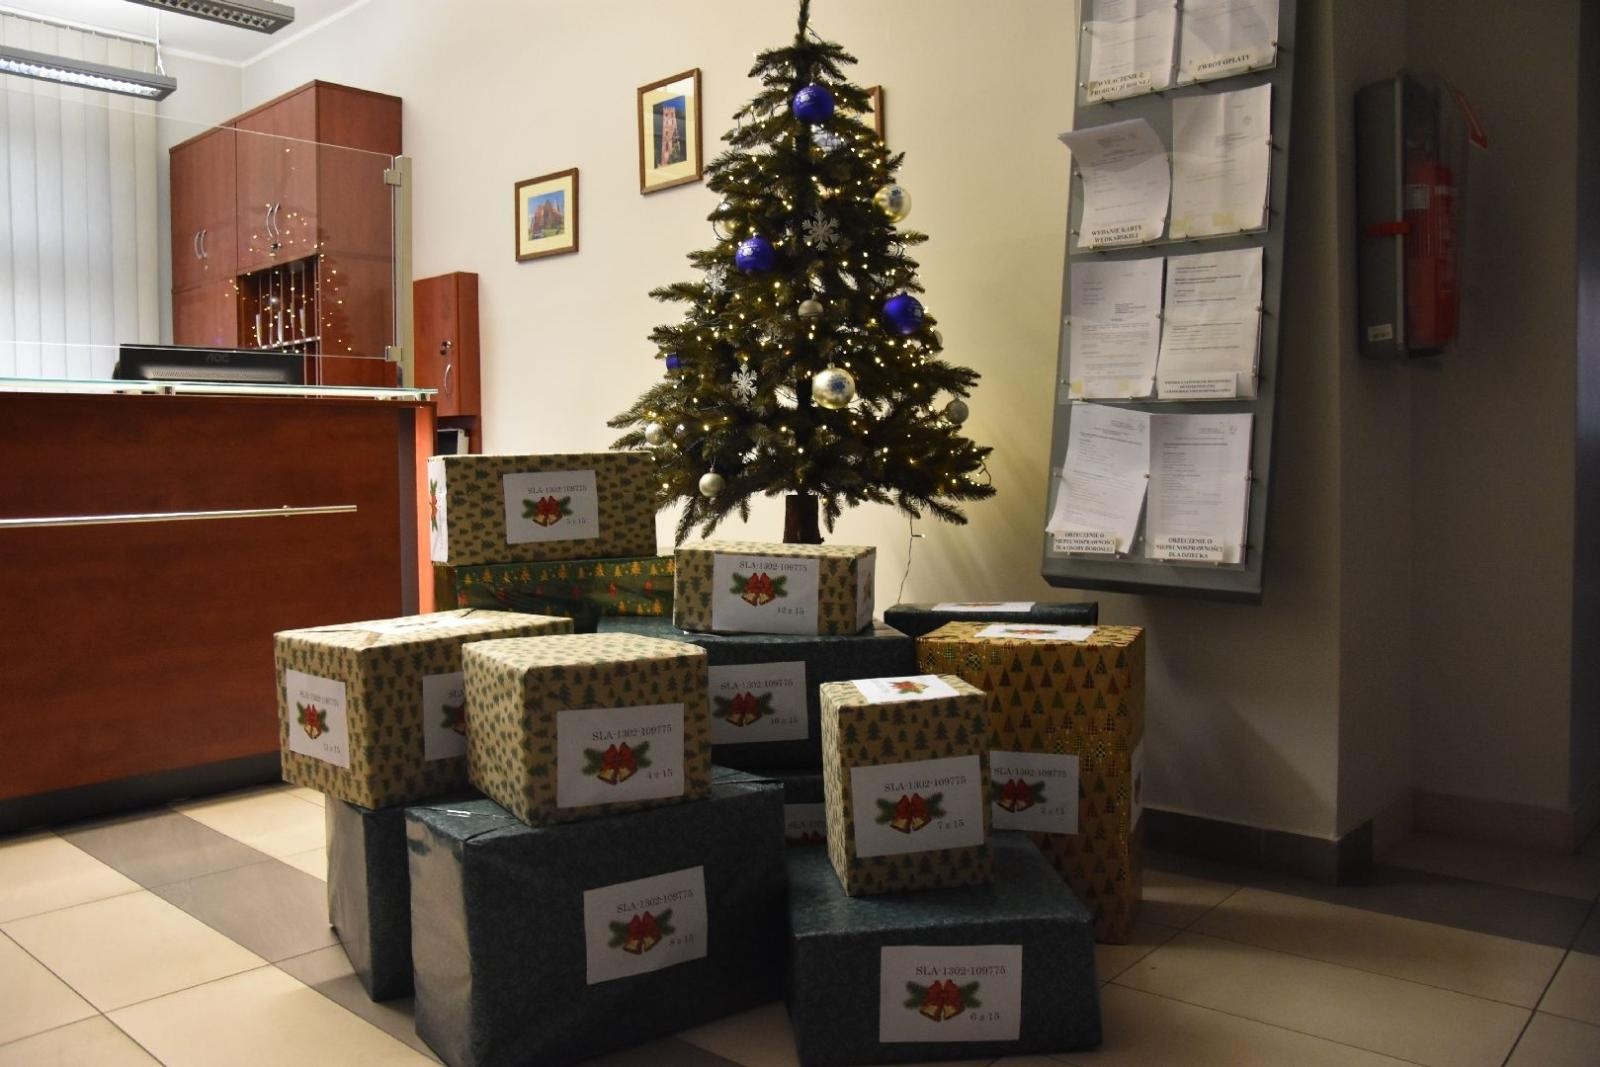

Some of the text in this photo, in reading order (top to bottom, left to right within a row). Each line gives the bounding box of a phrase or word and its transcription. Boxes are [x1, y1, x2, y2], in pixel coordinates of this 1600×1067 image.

[1091, 224, 1142, 237] WYDANIE KARTY
[1168, 537, 1206, 545] ORZECZENIE
[738, 560, 808, 572] SLA-1302-109775
[795, 607, 805, 616] 15
[720, 679, 794, 690] SLA-1302-109775
[592, 724, 672, 741] SLA-1302-109775
[662, 768, 673, 778] 15
[994, 767, 1068, 778] SLA-1302-109775
[884, 776, 967, 792] SLA-1302-109775
[954, 819, 965, 828] 15
[616, 888, 694, 914] SLA-1302-109775
[916, 965, 1006, 977] SLA-1302-109775
[970, 1012, 976, 1020] 6
[988, 1012, 1000, 1021] 15
